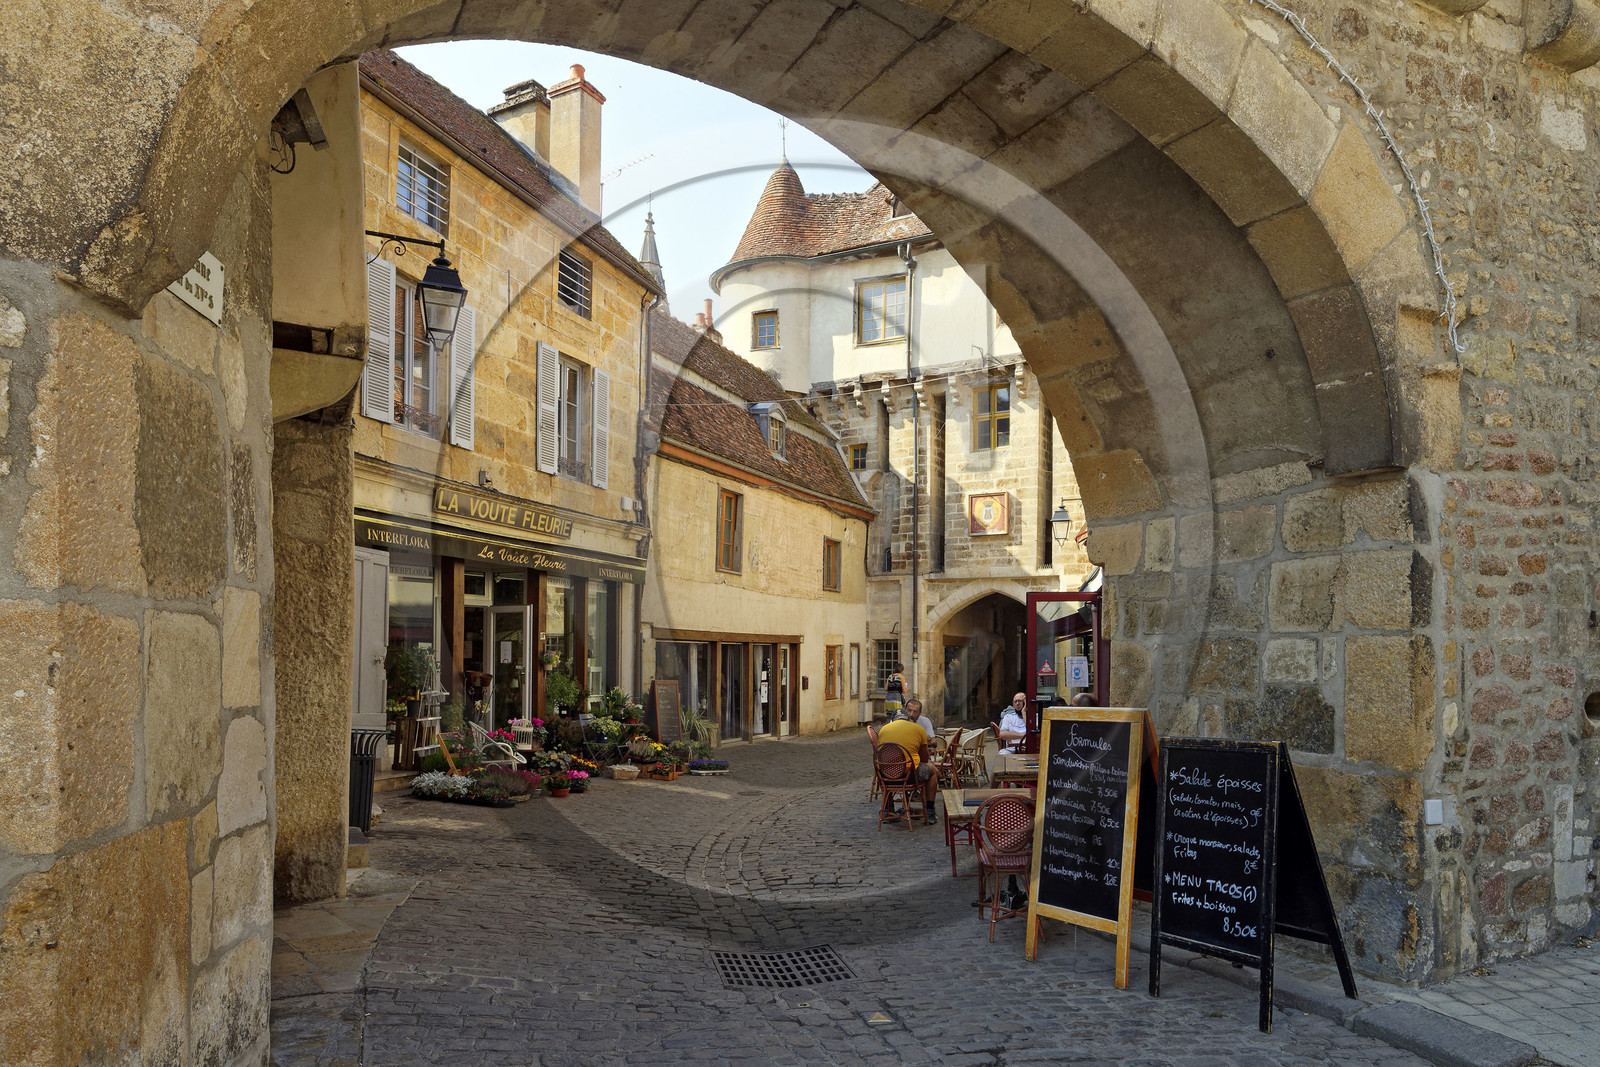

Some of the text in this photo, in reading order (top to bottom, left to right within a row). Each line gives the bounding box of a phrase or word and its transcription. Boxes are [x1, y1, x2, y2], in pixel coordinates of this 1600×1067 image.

[437, 490, 572, 537] LA VOUTE FLEURIE
[367, 527, 430, 550] INTERFLORA
[478, 545, 568, 571] La Voûte Fleurie
[599, 567, 633, 581] INTERFLORA
[1097, 786, 1118, 798] 7,50€
[1217, 774, 1262, 795] époisses
[1091, 800, 1111, 815] 7,50€
[1100, 816, 1120, 829] 8,50€
[1244, 860, 1258, 874] 8€
[1104, 873, 1118, 886] 12€
[1172, 871, 1202, 888] MENU
[1223, 916, 1258, 938] 8,50€
